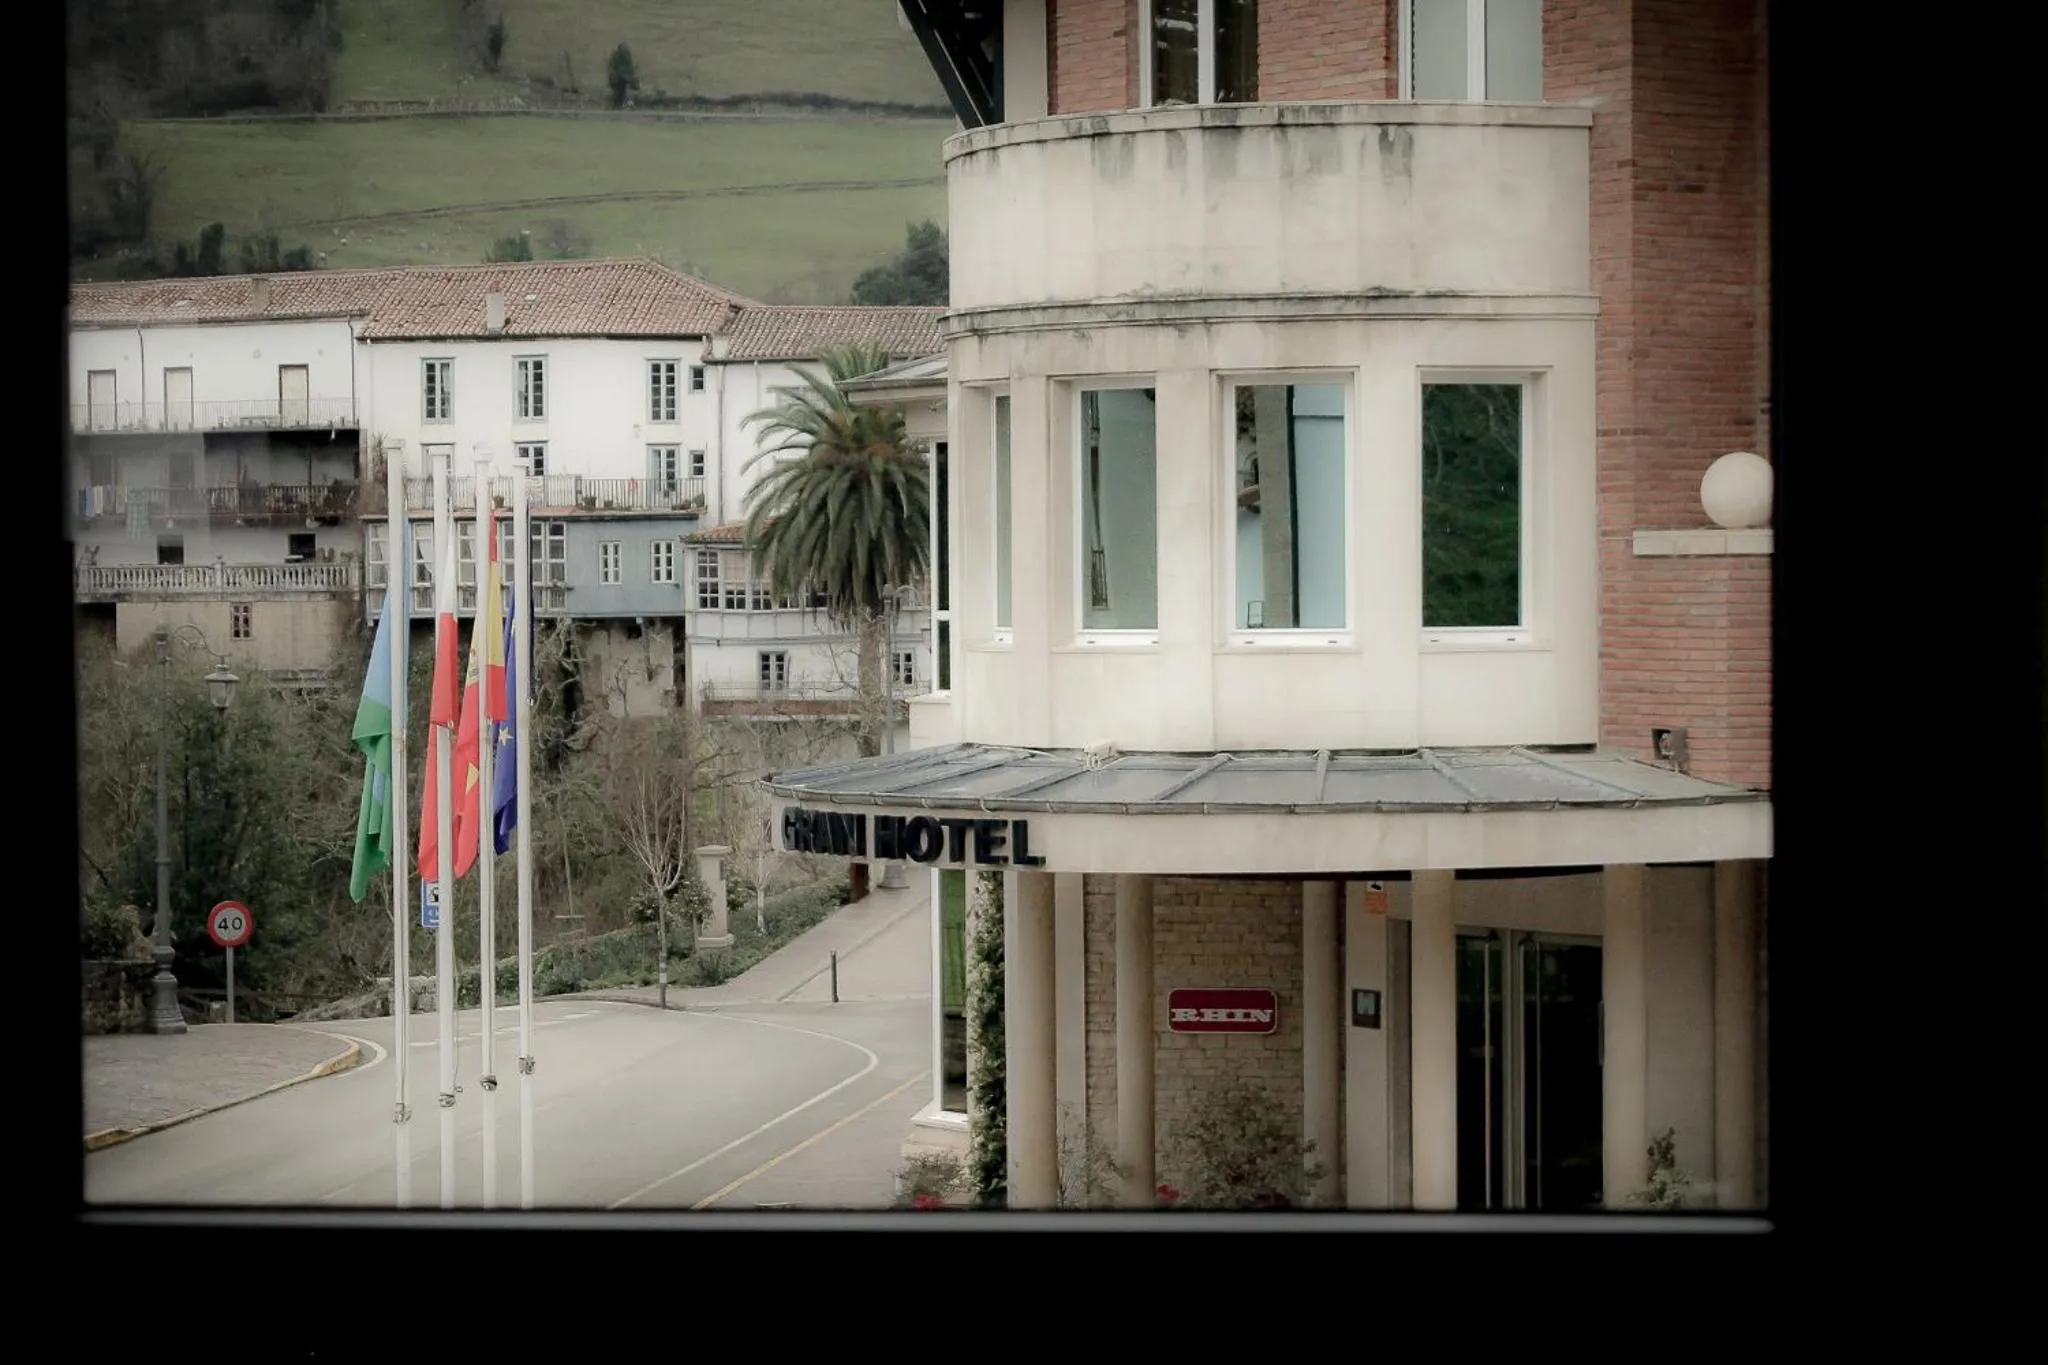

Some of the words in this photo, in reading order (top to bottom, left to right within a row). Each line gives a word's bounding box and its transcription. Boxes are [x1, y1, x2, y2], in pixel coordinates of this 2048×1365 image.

[782, 806, 867, 856] GRAN
[874, 815, 1046, 865] HOTEL
[218, 916, 243, 931] 40
[1170, 1008, 1273, 1022] RHIN
